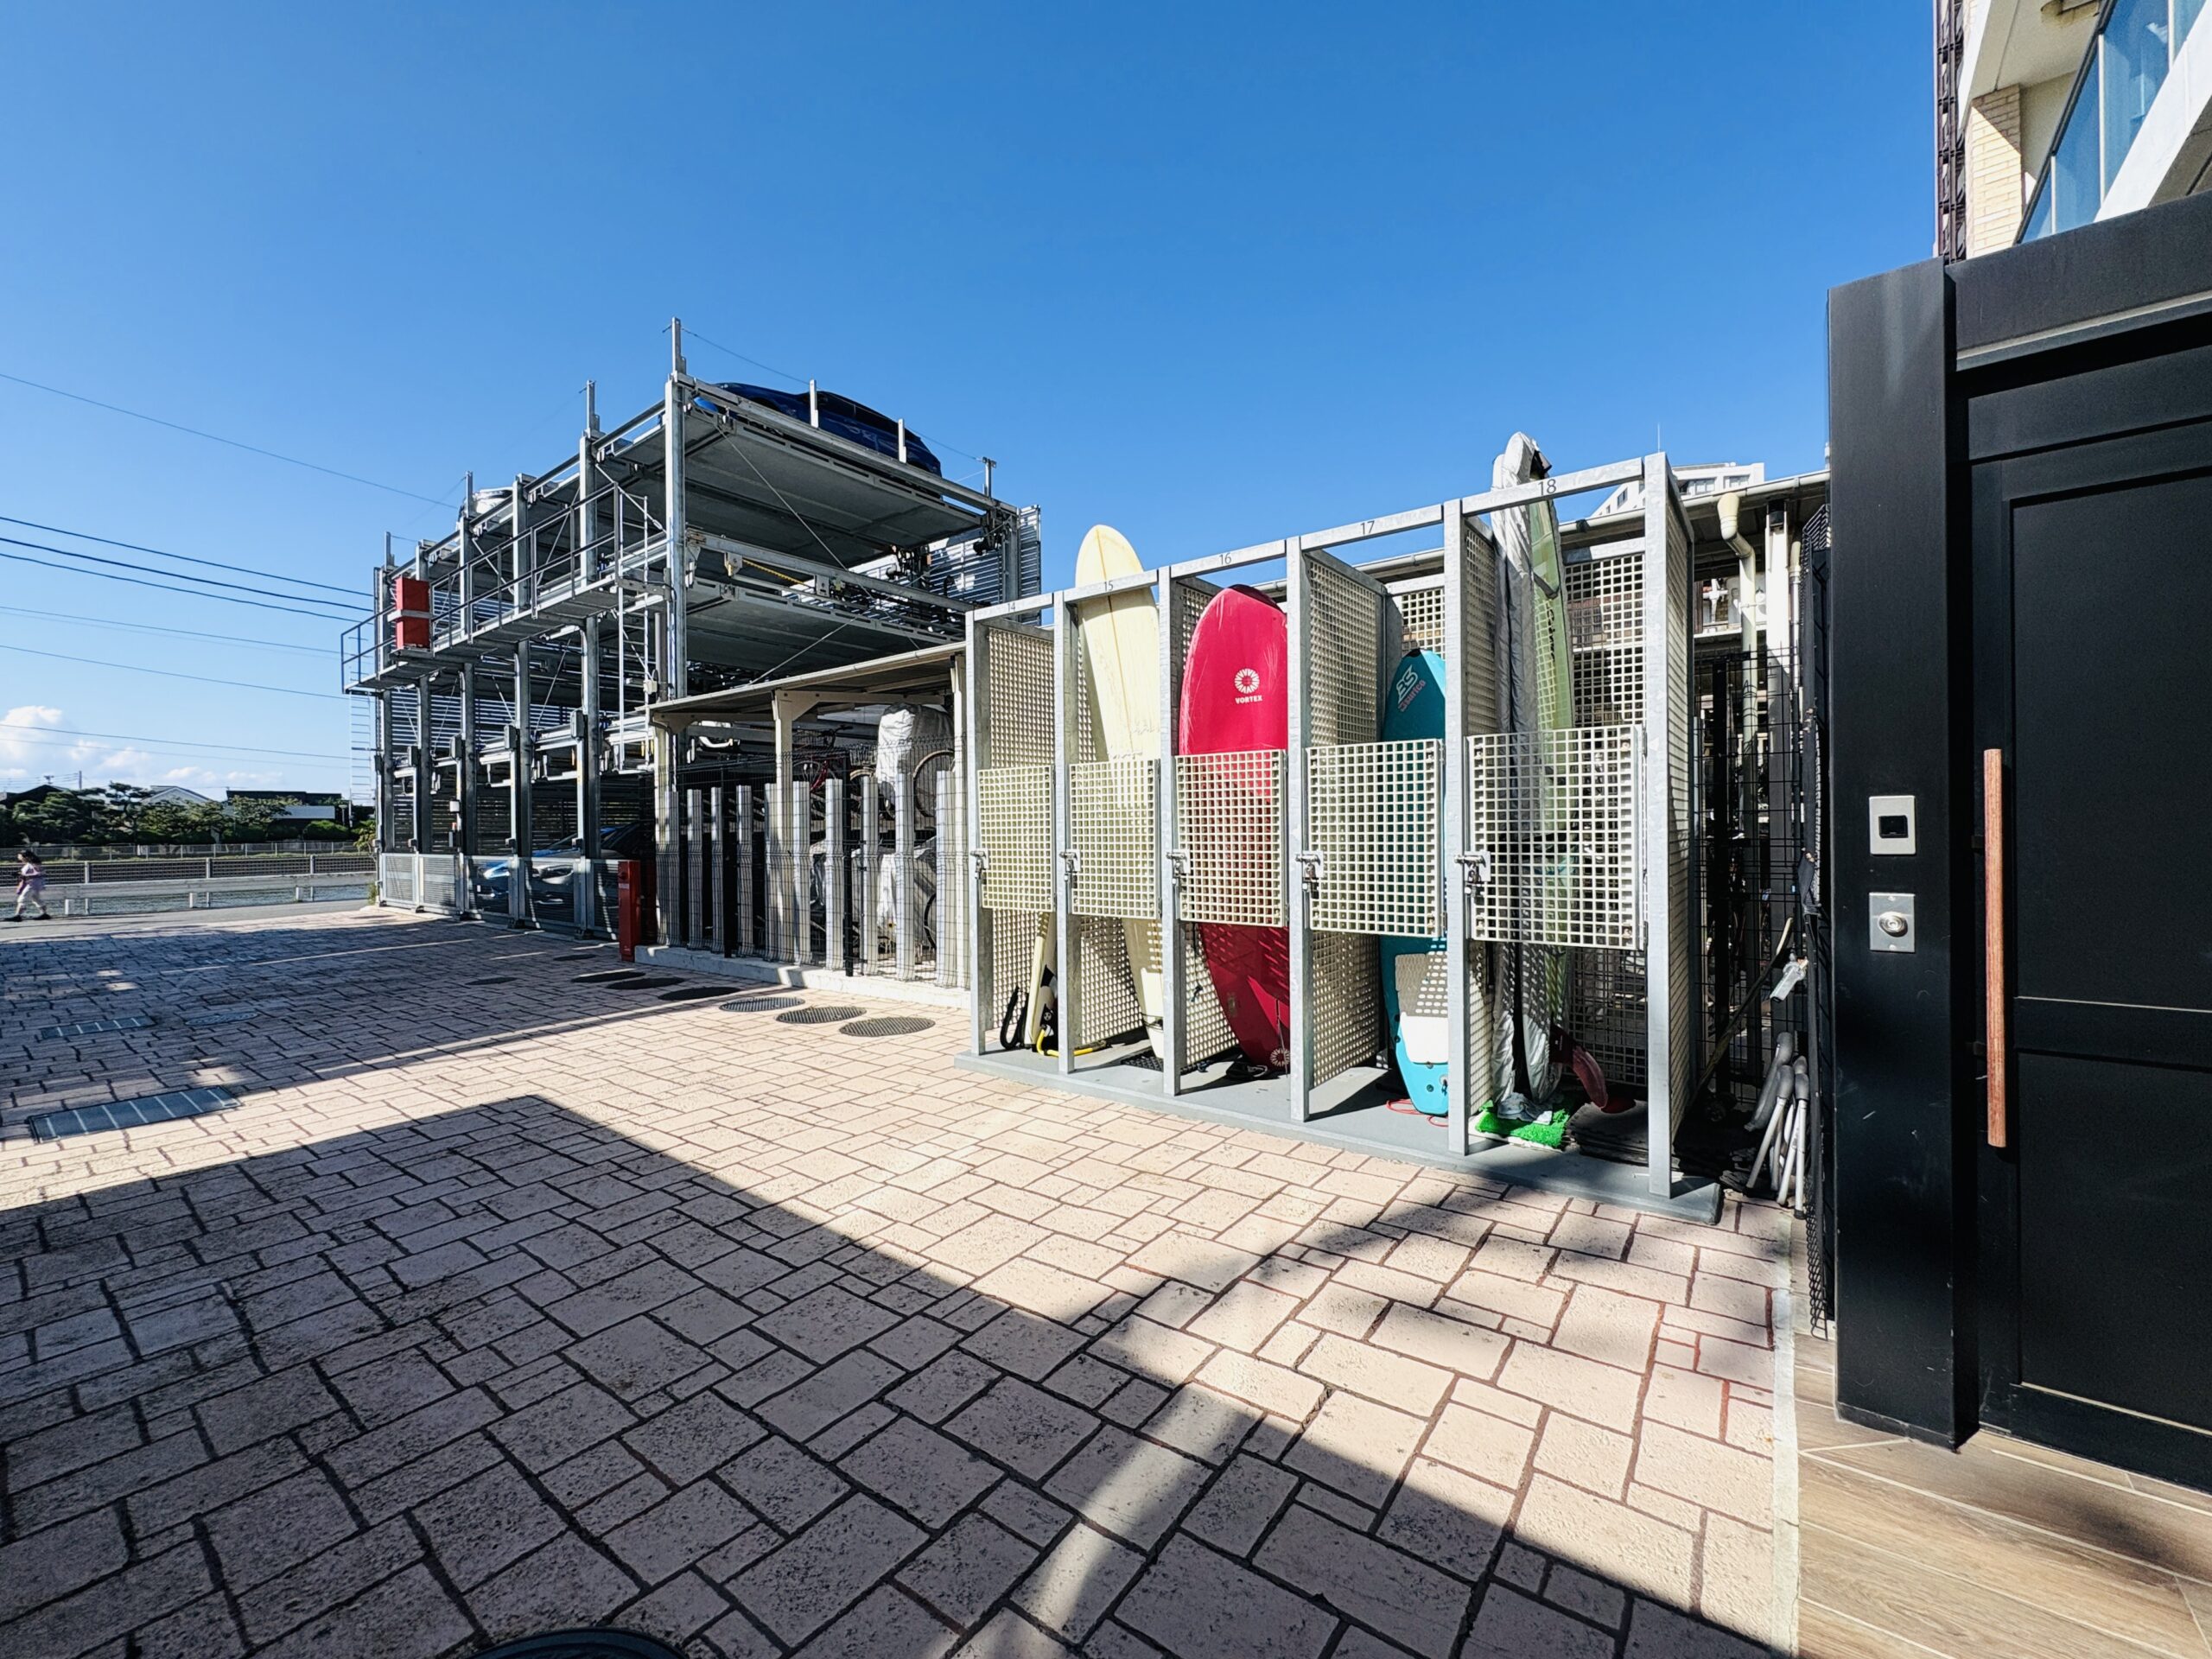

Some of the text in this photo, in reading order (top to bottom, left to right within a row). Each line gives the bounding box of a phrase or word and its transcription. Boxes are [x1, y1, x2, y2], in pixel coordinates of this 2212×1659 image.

[1538, 479, 1556, 496] 18
[1360, 520, 1375, 535] 17
[1219, 553, 1232, 565] 16
[1104, 580, 1114, 592] 15
[1007, 601, 1016, 613] 14
[1235, 695, 1263, 704] VORTEX
